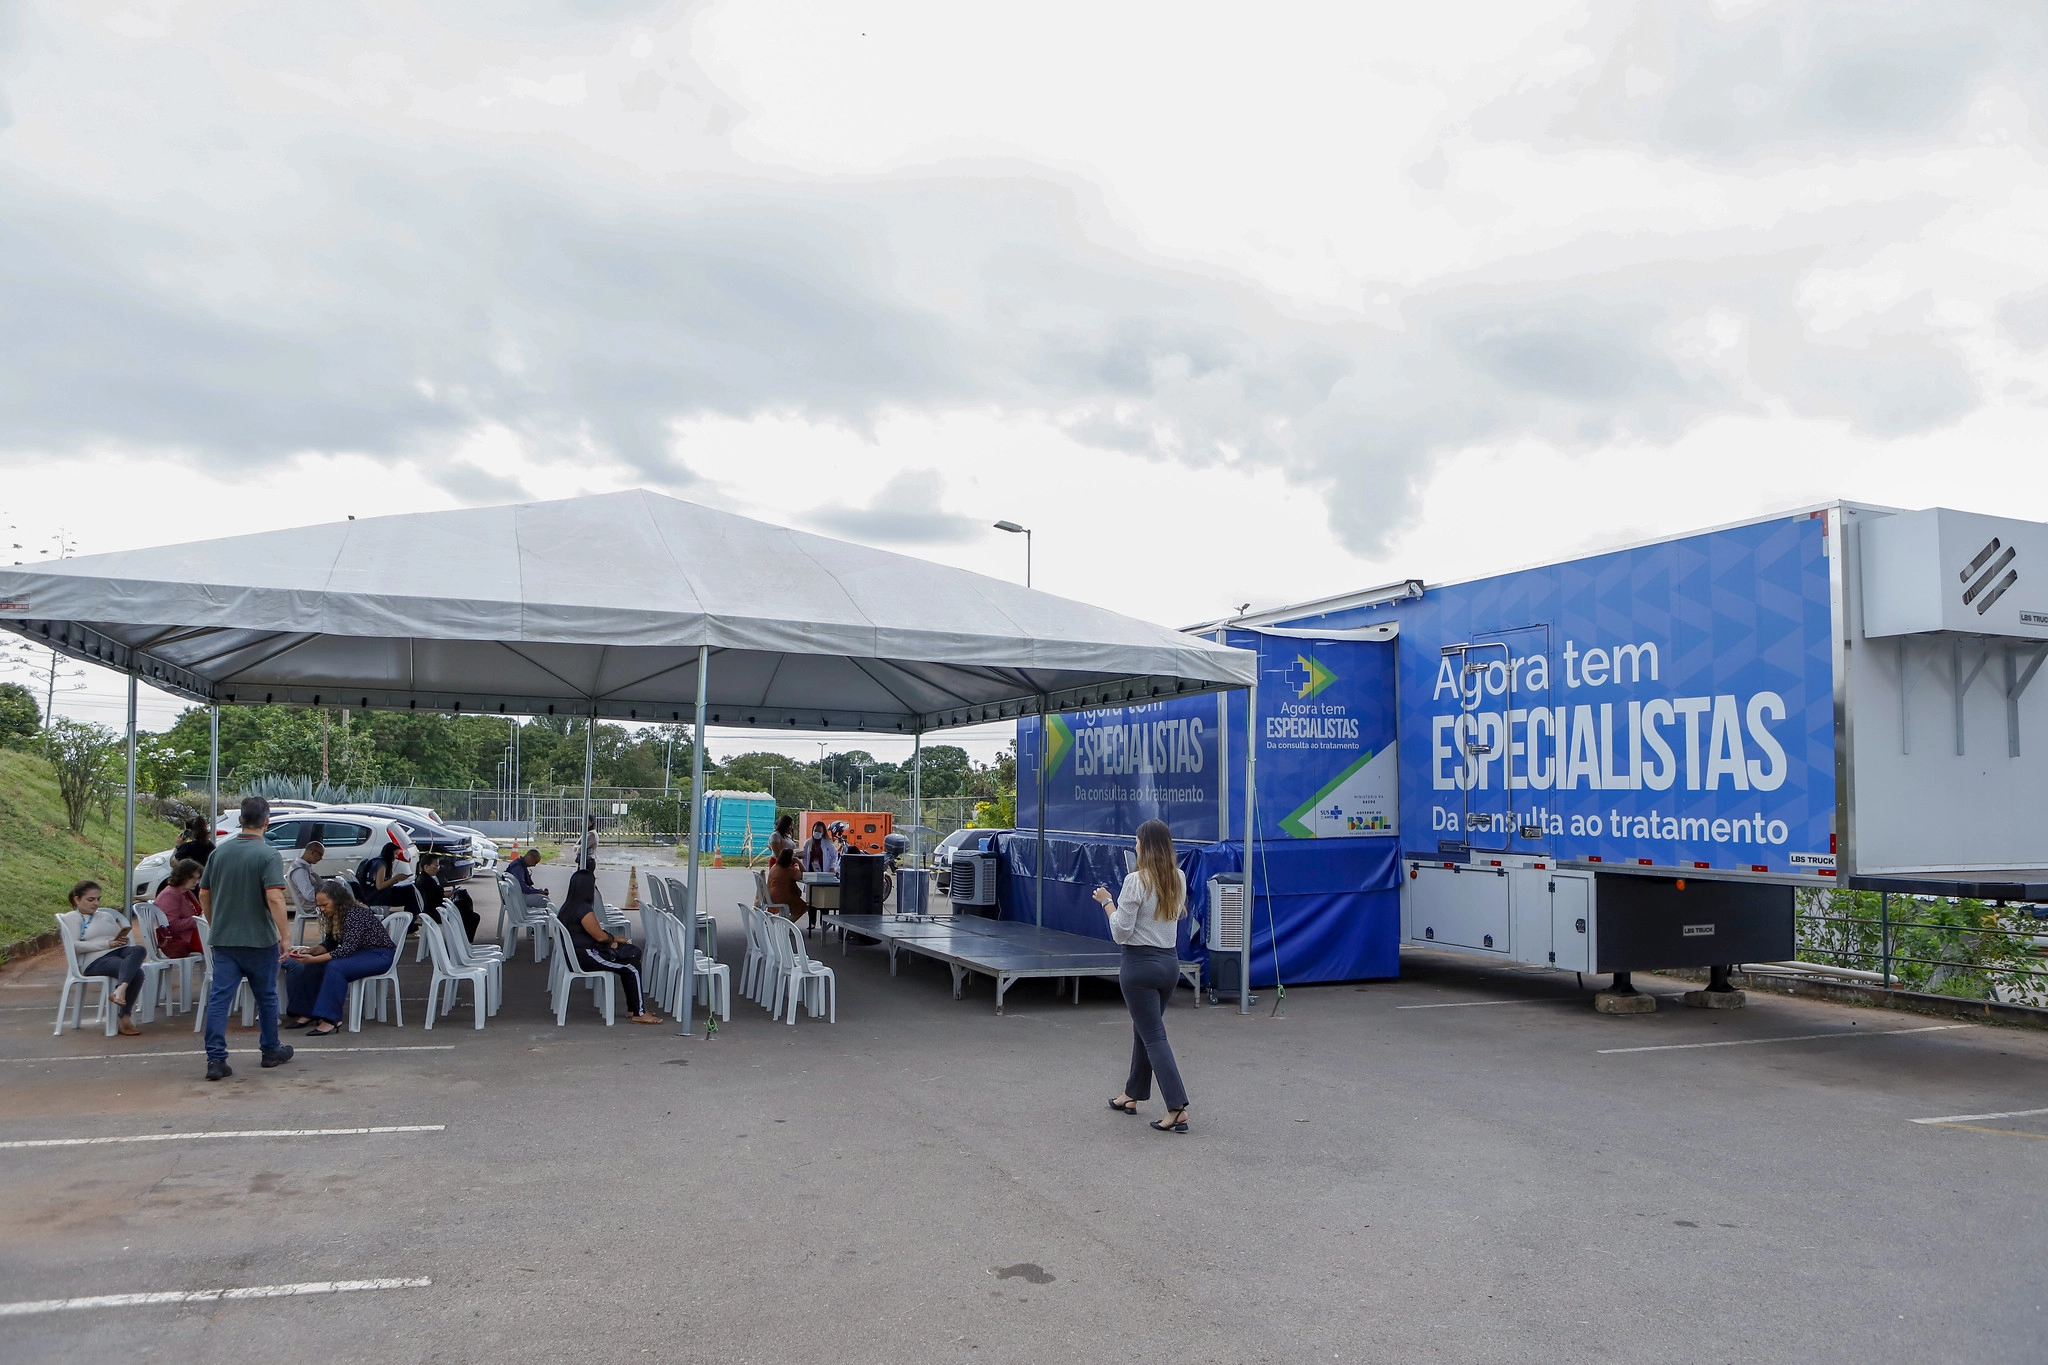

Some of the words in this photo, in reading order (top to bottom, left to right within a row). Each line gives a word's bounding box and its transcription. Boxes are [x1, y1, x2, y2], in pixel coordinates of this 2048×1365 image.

[2033, 615, 2048, 623] TRUC
[1433, 654, 1549, 711] Agora
[1563, 640, 1658, 689] tem
[1280, 701, 1318, 718] Agora
[1321, 702, 1346, 715] tem
[1266, 717, 1359, 739] ESPECIALISTAS
[1075, 717, 1204, 776] ESPECIALISTAS
[1320, 742, 1360, 750] tratamento
[1432, 691, 1788, 792] ESPECIALISTAS
[1075, 785, 1087, 801] Da
[1088, 783, 1128, 801] consulta
[1129, 787, 1143, 801] ao
[1145, 783, 1204, 803] tratamento
[1347, 816, 1391, 830] BRASIL
[1432, 805, 1459, 833] Da
[1570, 814, 1603, 837] ao
[1610, 809, 1789, 845] tratamento
[1791, 855, 1806, 863] LBS
[1807, 856, 1835, 865] TRUCK
